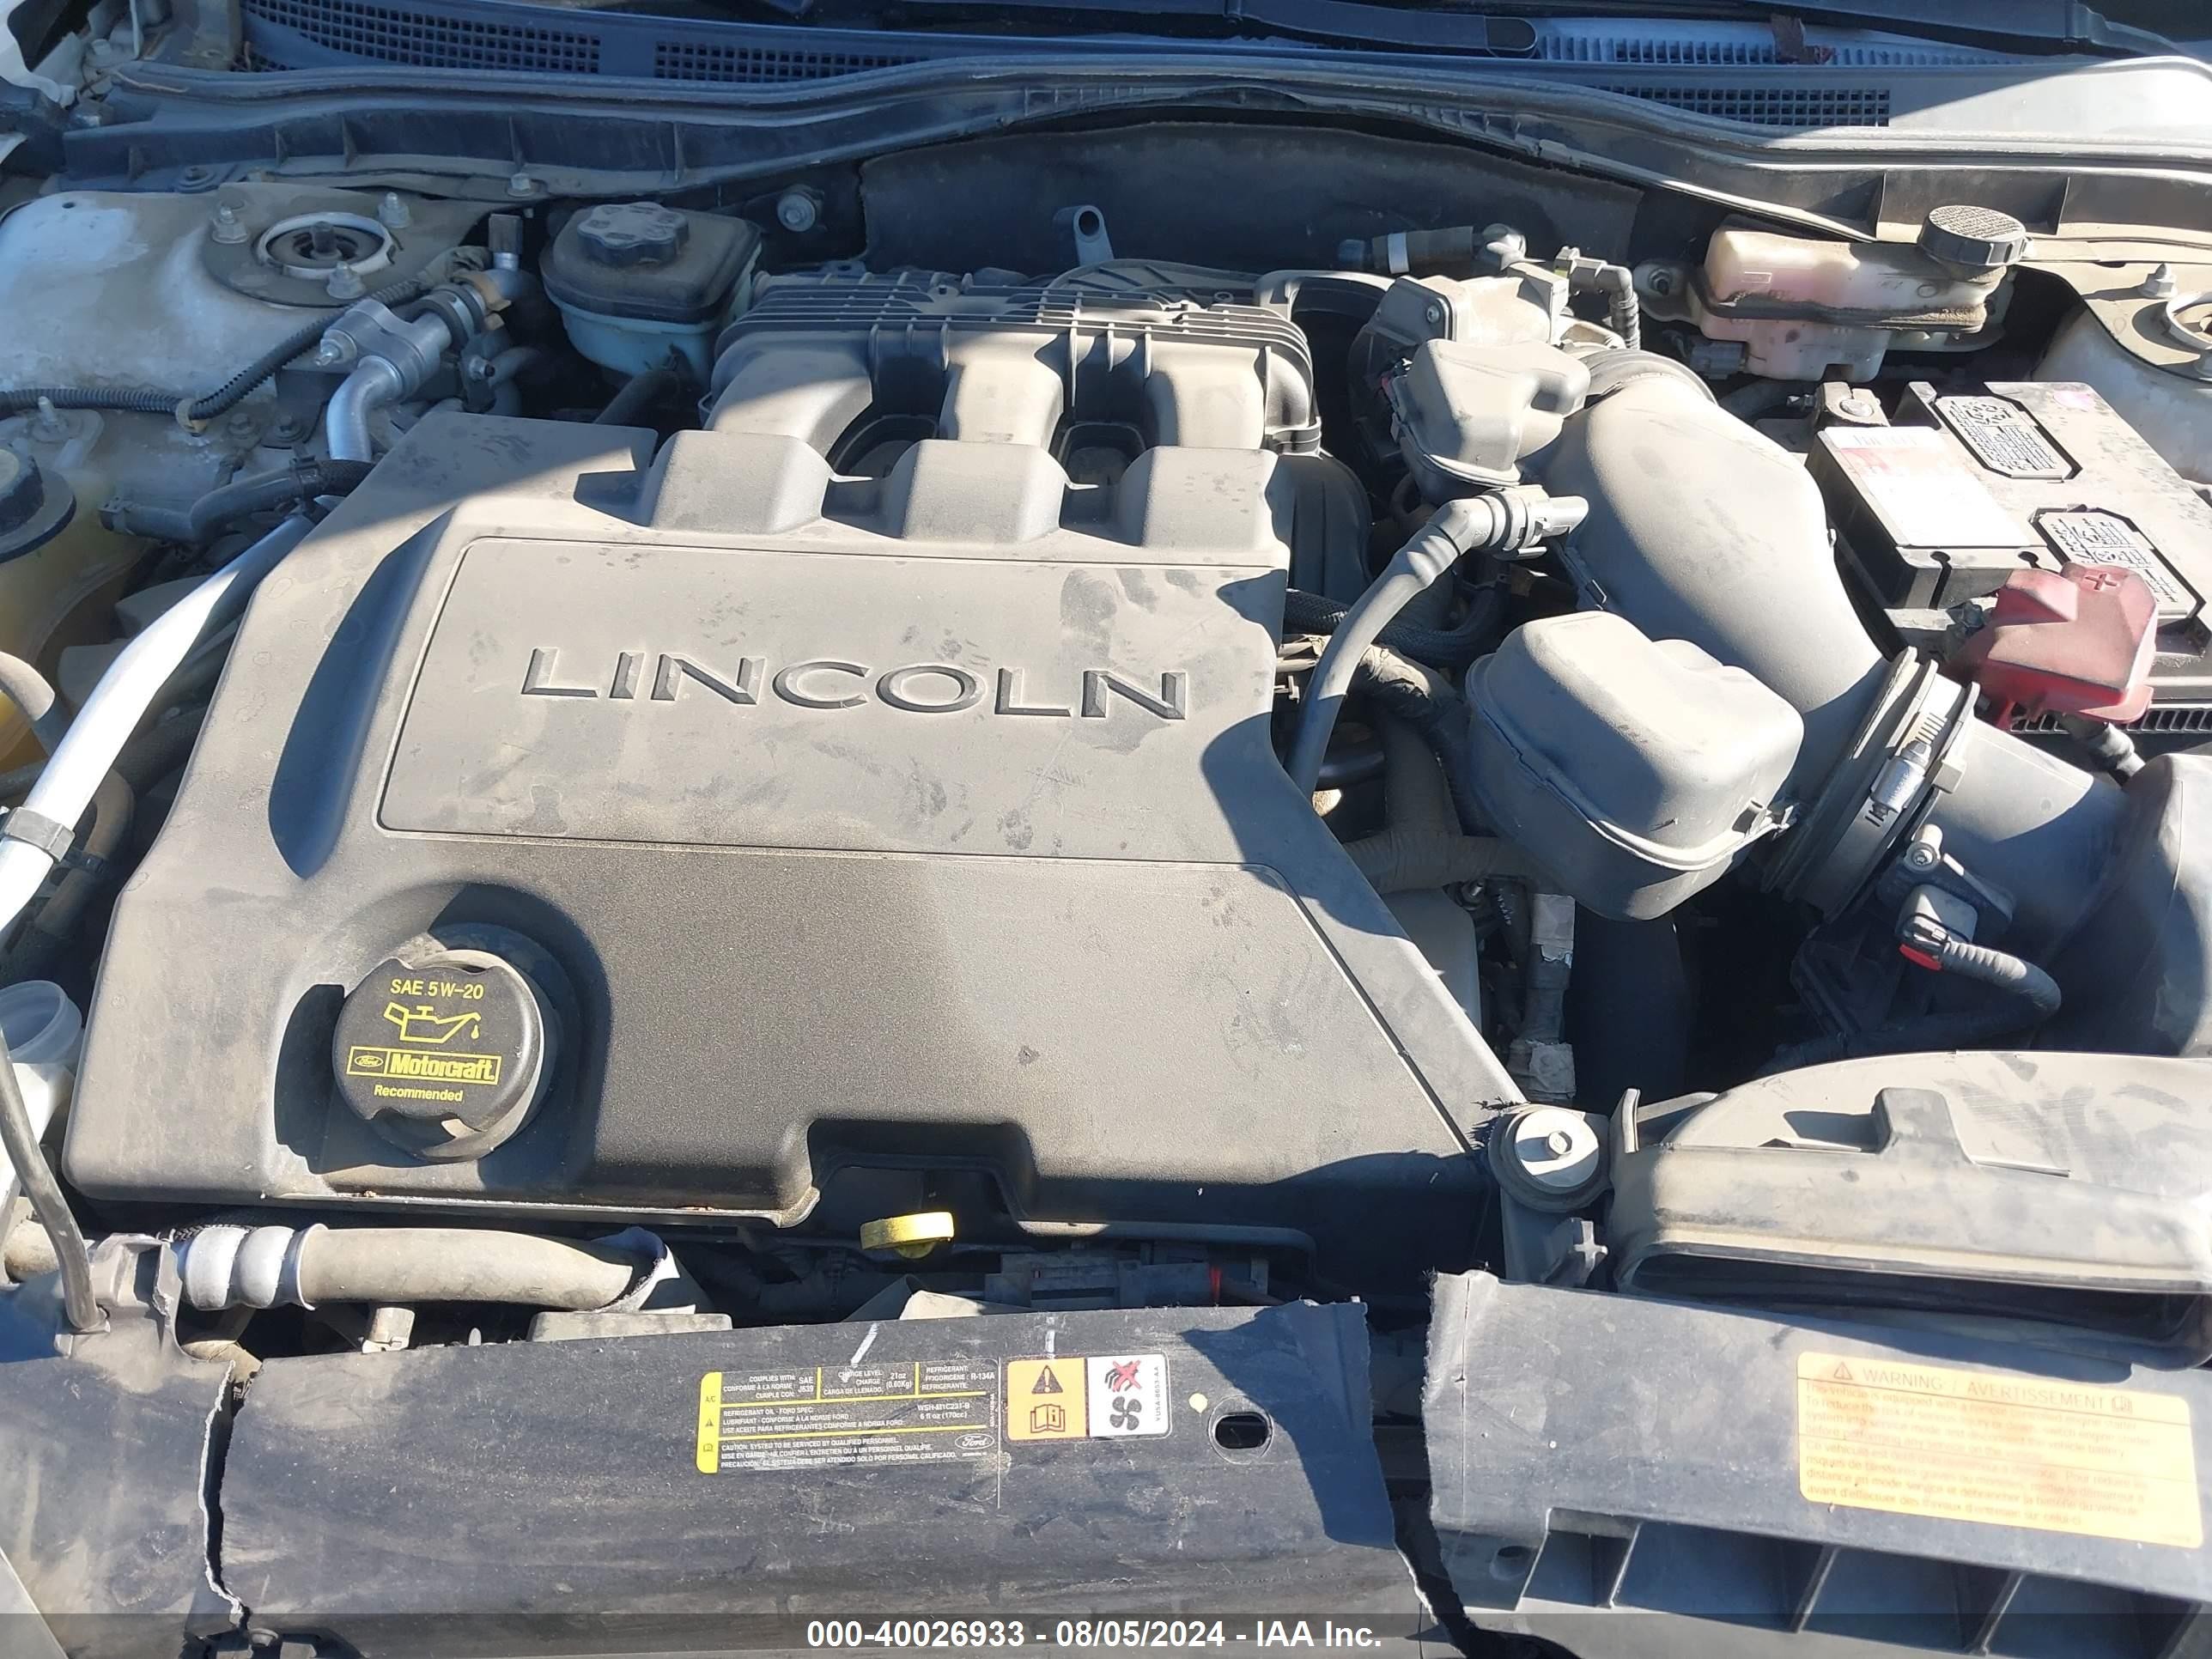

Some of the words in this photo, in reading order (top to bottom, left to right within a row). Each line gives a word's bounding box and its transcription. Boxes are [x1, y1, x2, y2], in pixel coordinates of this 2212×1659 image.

[520, 646, 1187, 721] LINCOLN
[390, 979, 424, 995] SAE
[428, 981, 484, 1000] 5W-20
[374, 1085, 464, 1102] Recommended
[970, 1372, 995, 1381] R-134A
[1863, 1369, 1942, 1390] WARNING
[1967, 1382, 2103, 1409] AVERTISSEMENT
[960, 1434, 990, 1448] Ford
